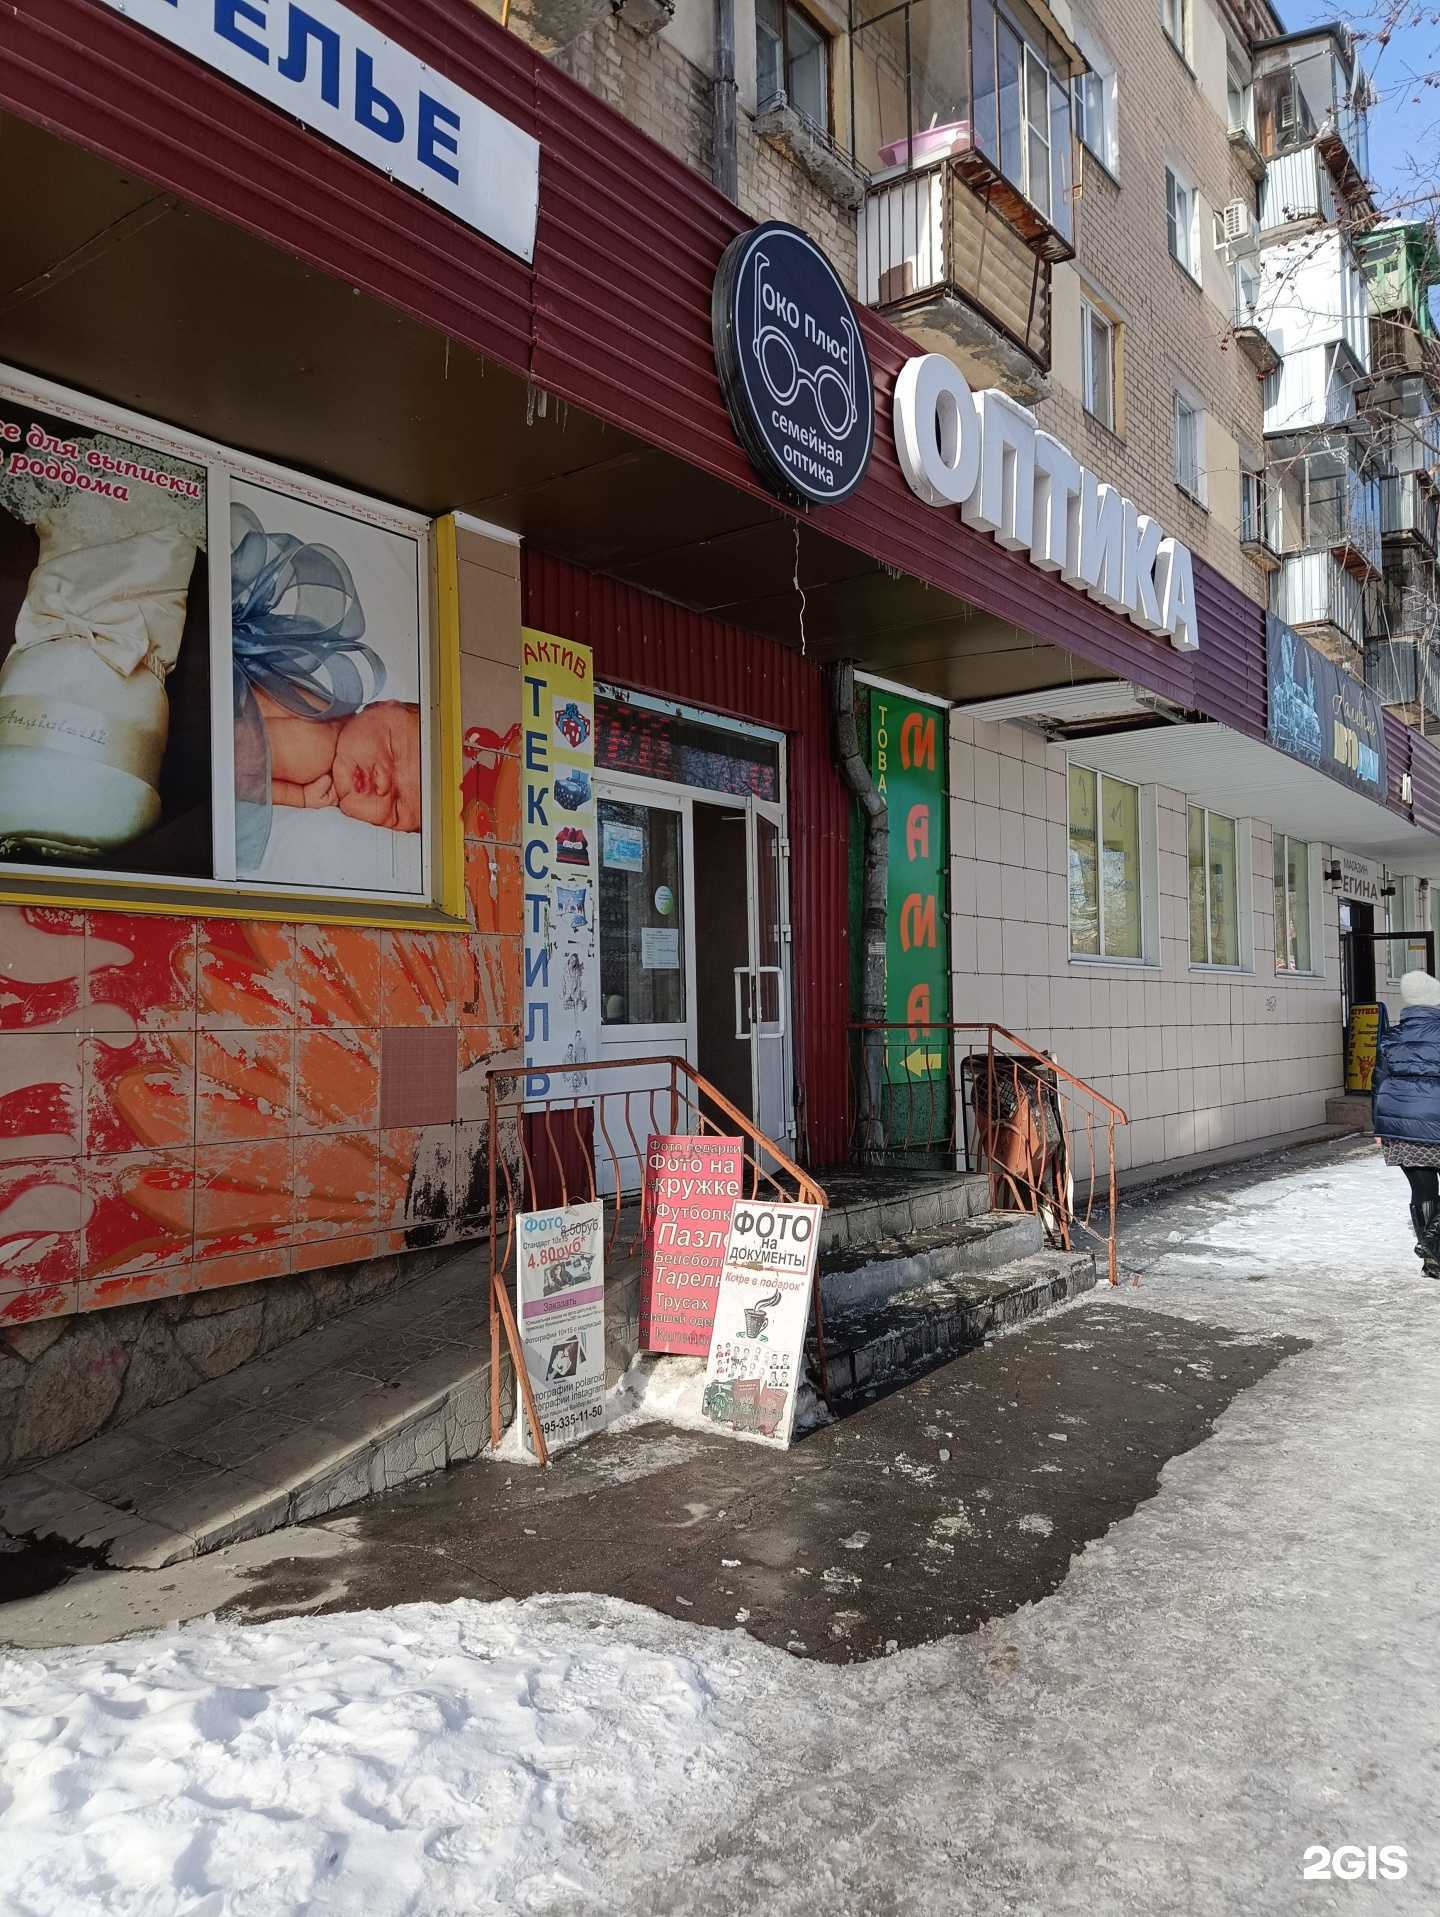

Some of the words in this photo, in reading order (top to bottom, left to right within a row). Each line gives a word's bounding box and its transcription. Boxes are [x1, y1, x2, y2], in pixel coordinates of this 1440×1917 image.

[165, 0, 461, 186] ЕЛЬЕ
[762, 283, 800, 329] ОКО
[804, 312, 849, 365] Плюс
[771, 409, 843, 467] семейная
[9, 453, 129, 501] роддома
[27, 425, 79, 459] для
[87, 451, 200, 497] выписки
[783, 444, 834, 487] оптика
[523, 641, 587, 679] АКТИВ
[877, 705, 888, 804] ТОВА
[523, 676, 550, 1097] ТЕКСТИЛЬ
[1340, 874, 1378, 900] ЕГИНА
[649, 1153, 703, 1172] Фото
[710, 1159, 735, 1174] на
[655, 1178, 740, 1200] кружке
[524, 1216, 563, 1233] Фото
[656, 1202, 731, 1222] Футболк
[733, 1210, 812, 1242] ФОТО
[729, 1246, 806, 1267] ДОКУМЕНТЫ
[761, 1238, 778, 1250] на
[725, 1271, 750, 1286] Кофе
[655, 1292, 710, 1311] Трусах
